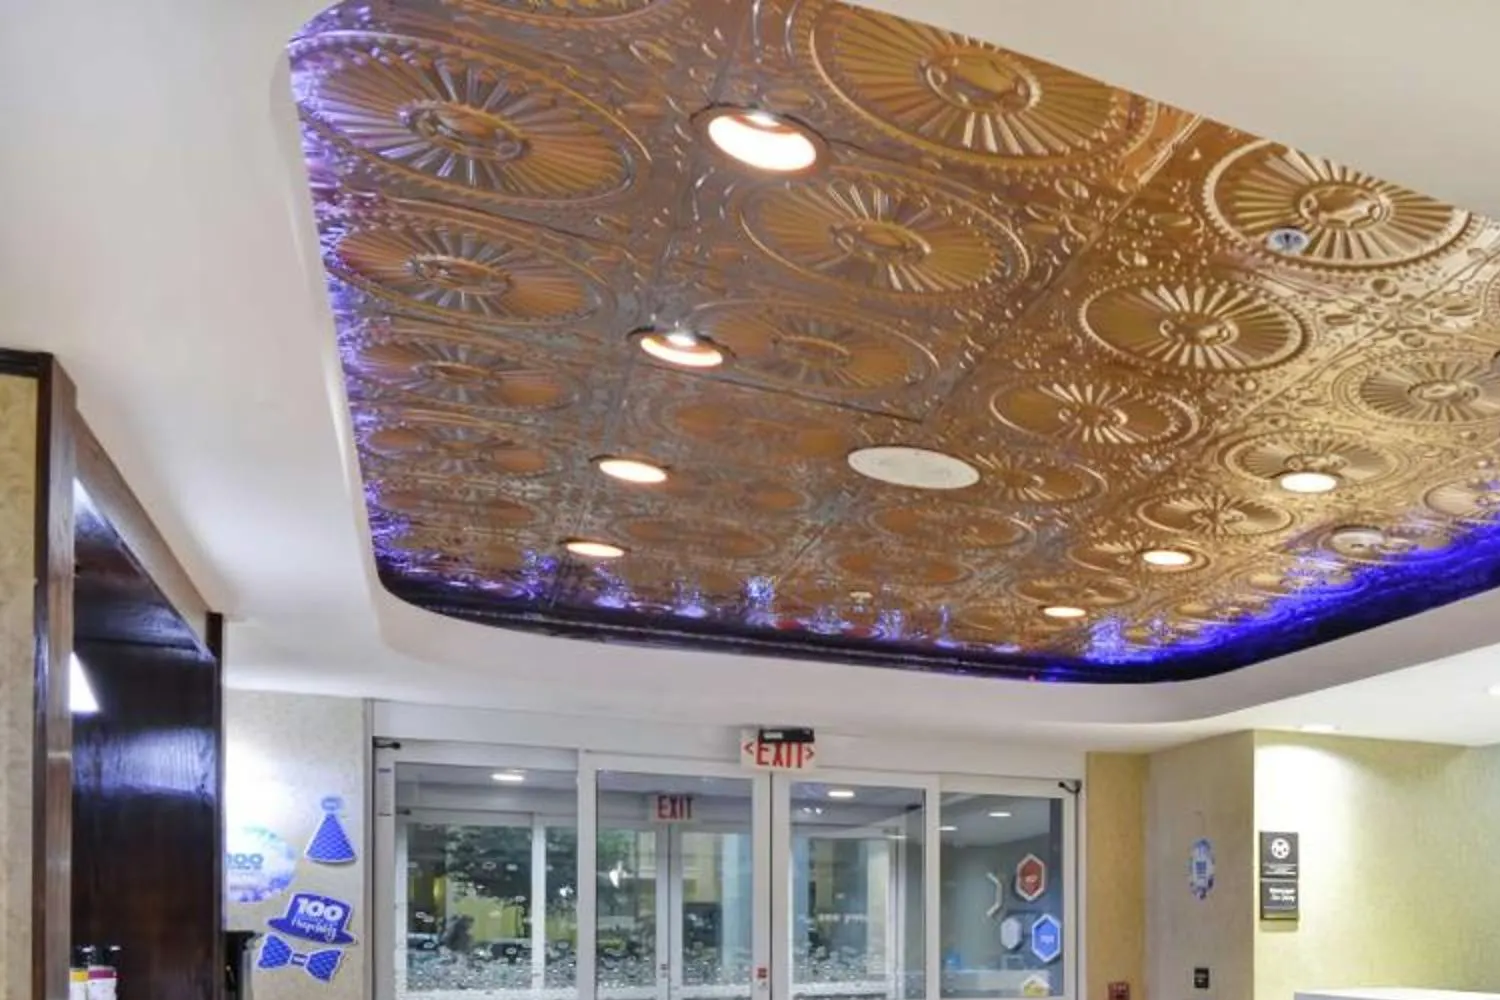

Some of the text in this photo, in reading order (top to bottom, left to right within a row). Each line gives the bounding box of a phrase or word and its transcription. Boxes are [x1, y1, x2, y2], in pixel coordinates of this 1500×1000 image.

[757, 739, 804, 768] EXIT
[657, 795, 693, 820] EXIT
[297, 897, 343, 922] 100
